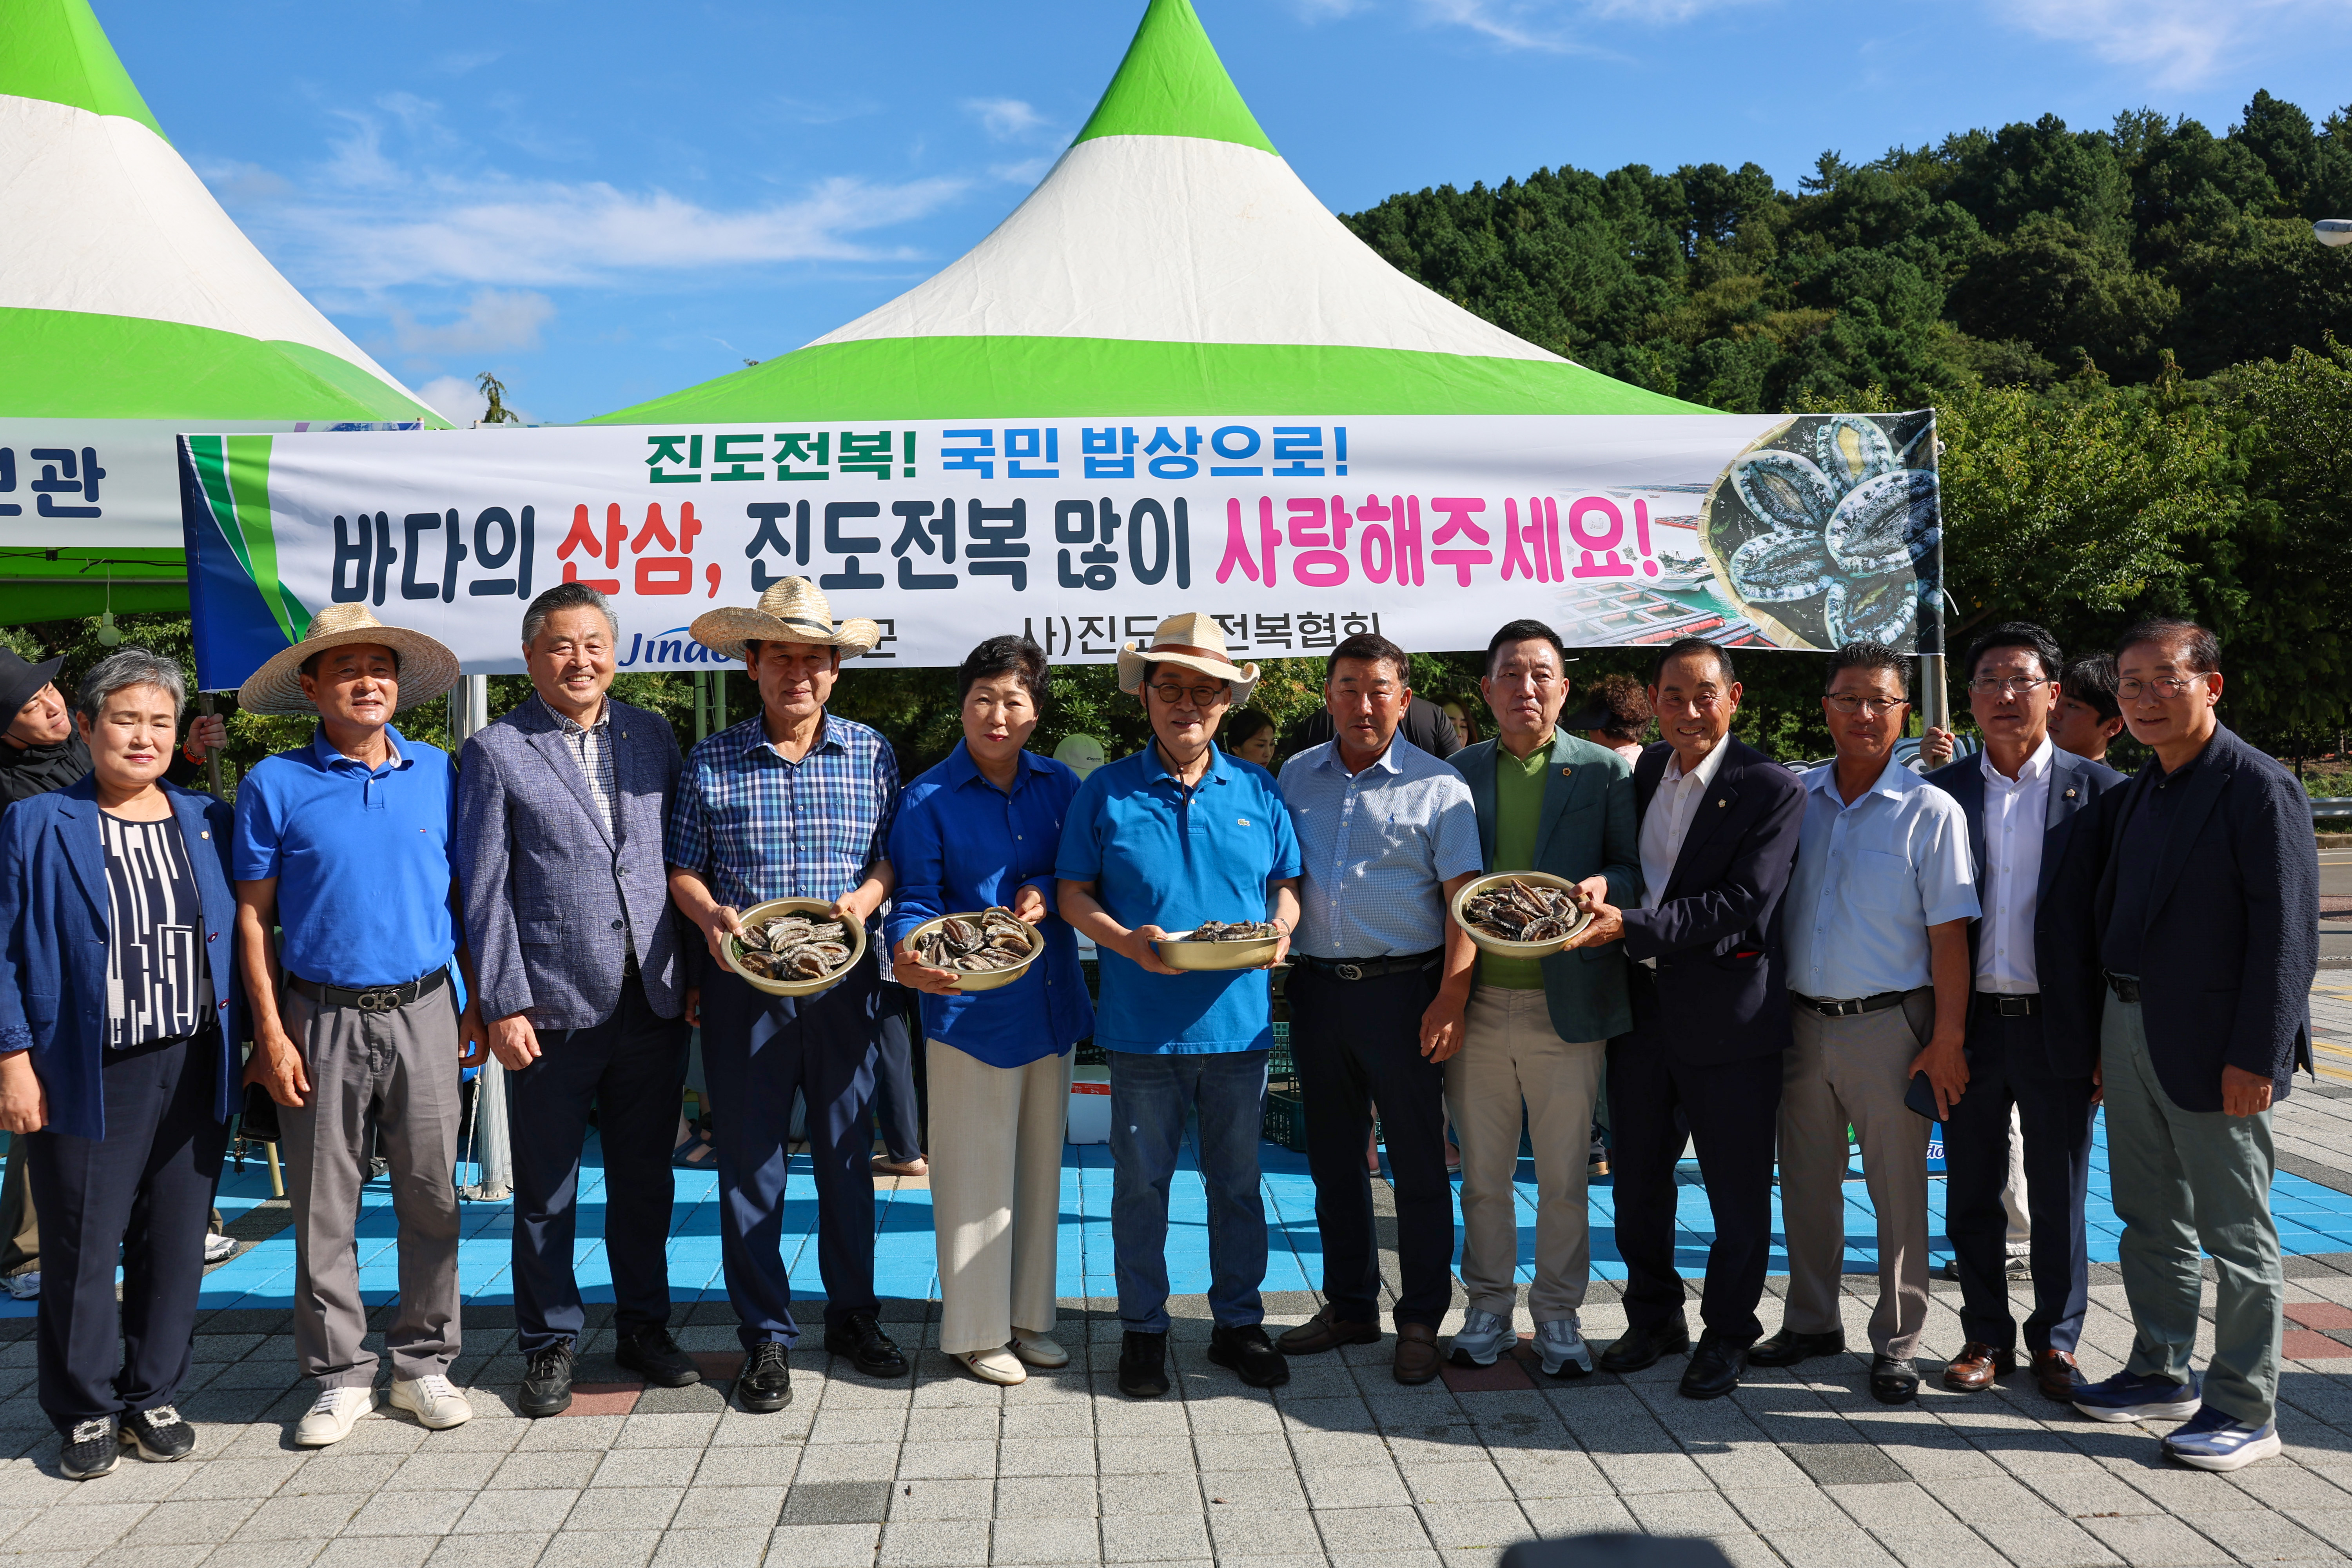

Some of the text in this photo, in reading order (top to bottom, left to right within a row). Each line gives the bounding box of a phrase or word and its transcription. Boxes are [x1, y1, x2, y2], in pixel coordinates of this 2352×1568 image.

[646, 425, 1348, 483] 진도전복! 국민 밥상으로!
[331, 494, 1658, 607] 바다의 산삼, 진도전복 많이 사랑해주세요!
